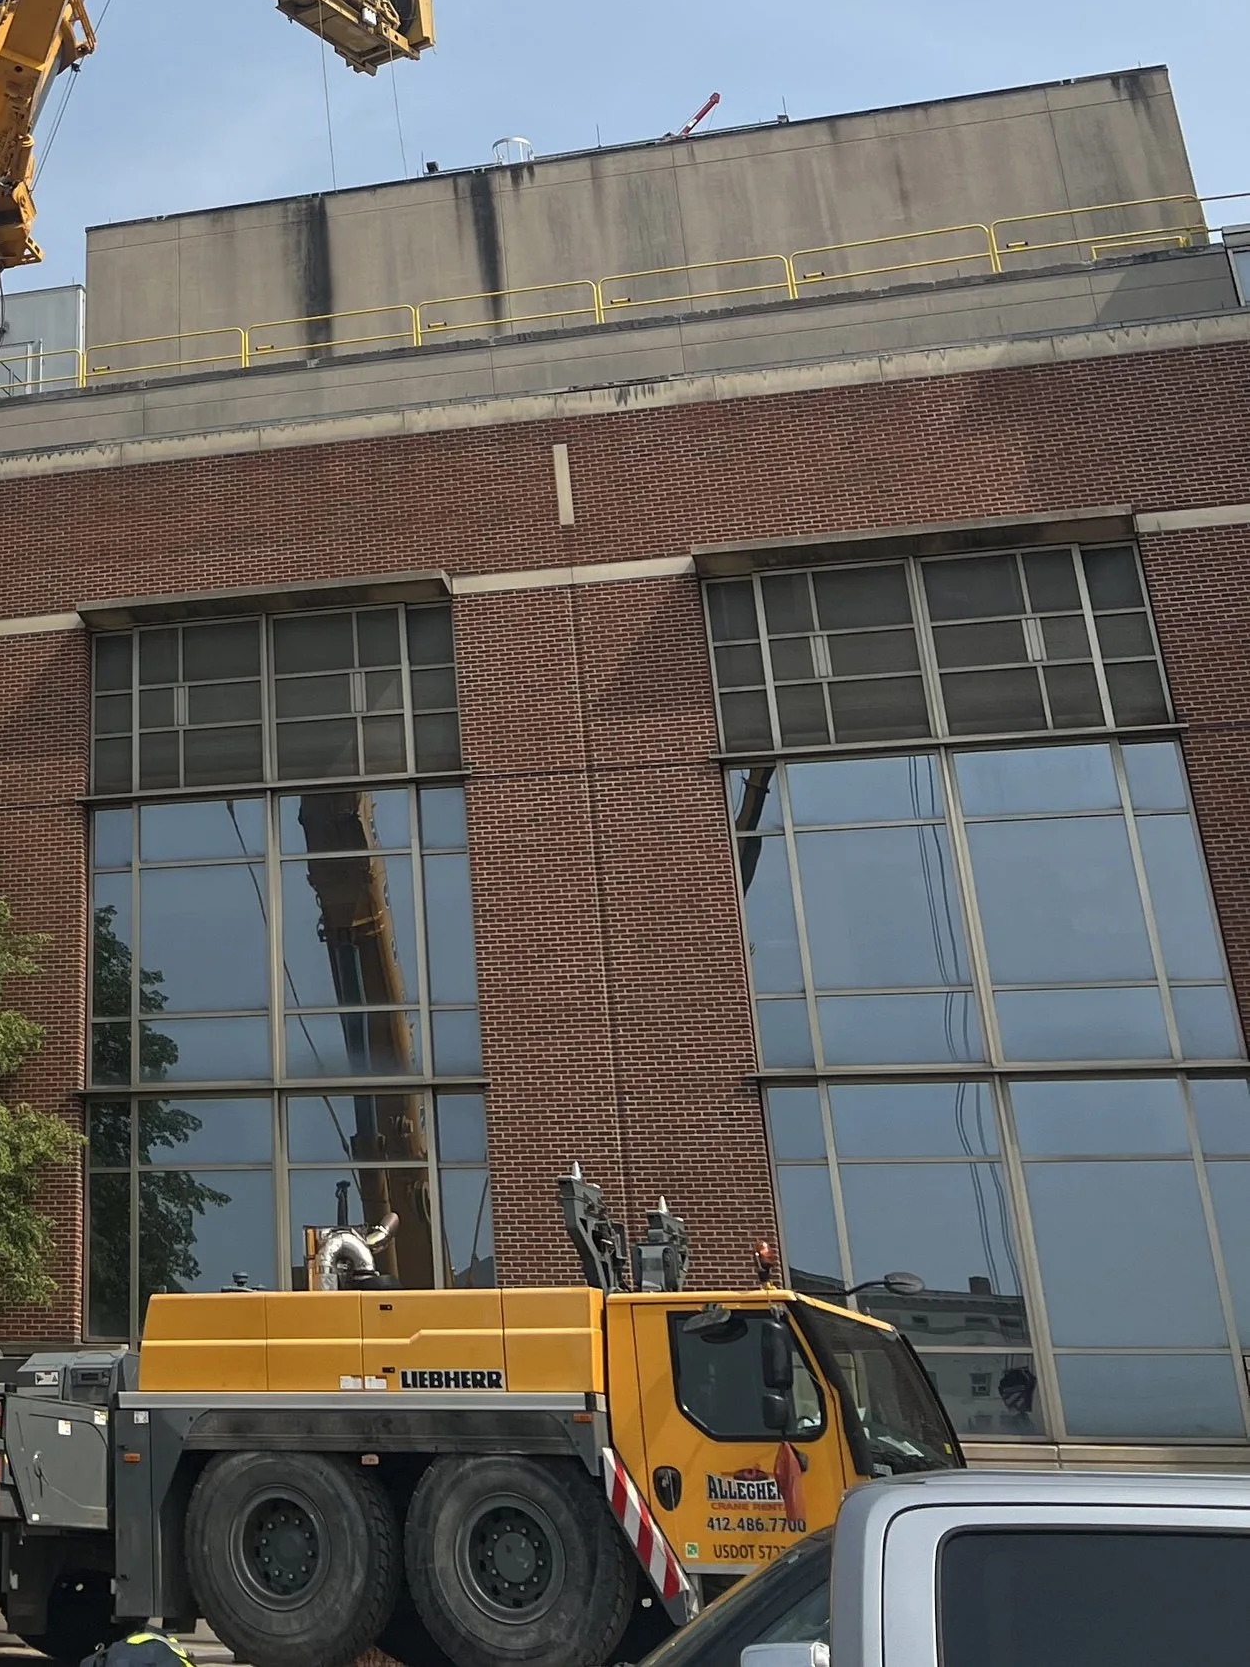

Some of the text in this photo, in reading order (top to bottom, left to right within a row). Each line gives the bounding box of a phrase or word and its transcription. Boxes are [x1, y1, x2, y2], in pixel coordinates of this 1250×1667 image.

[400, 1370, 503, 1389] LIEBHERR
[707, 1474, 784, 1500] ALLEGHE
[711, 1502, 786, 1511] CRANE RENT
[706, 1517, 807, 1532] 412.486.7700
[713, 1544, 755, 1559] USDOT
